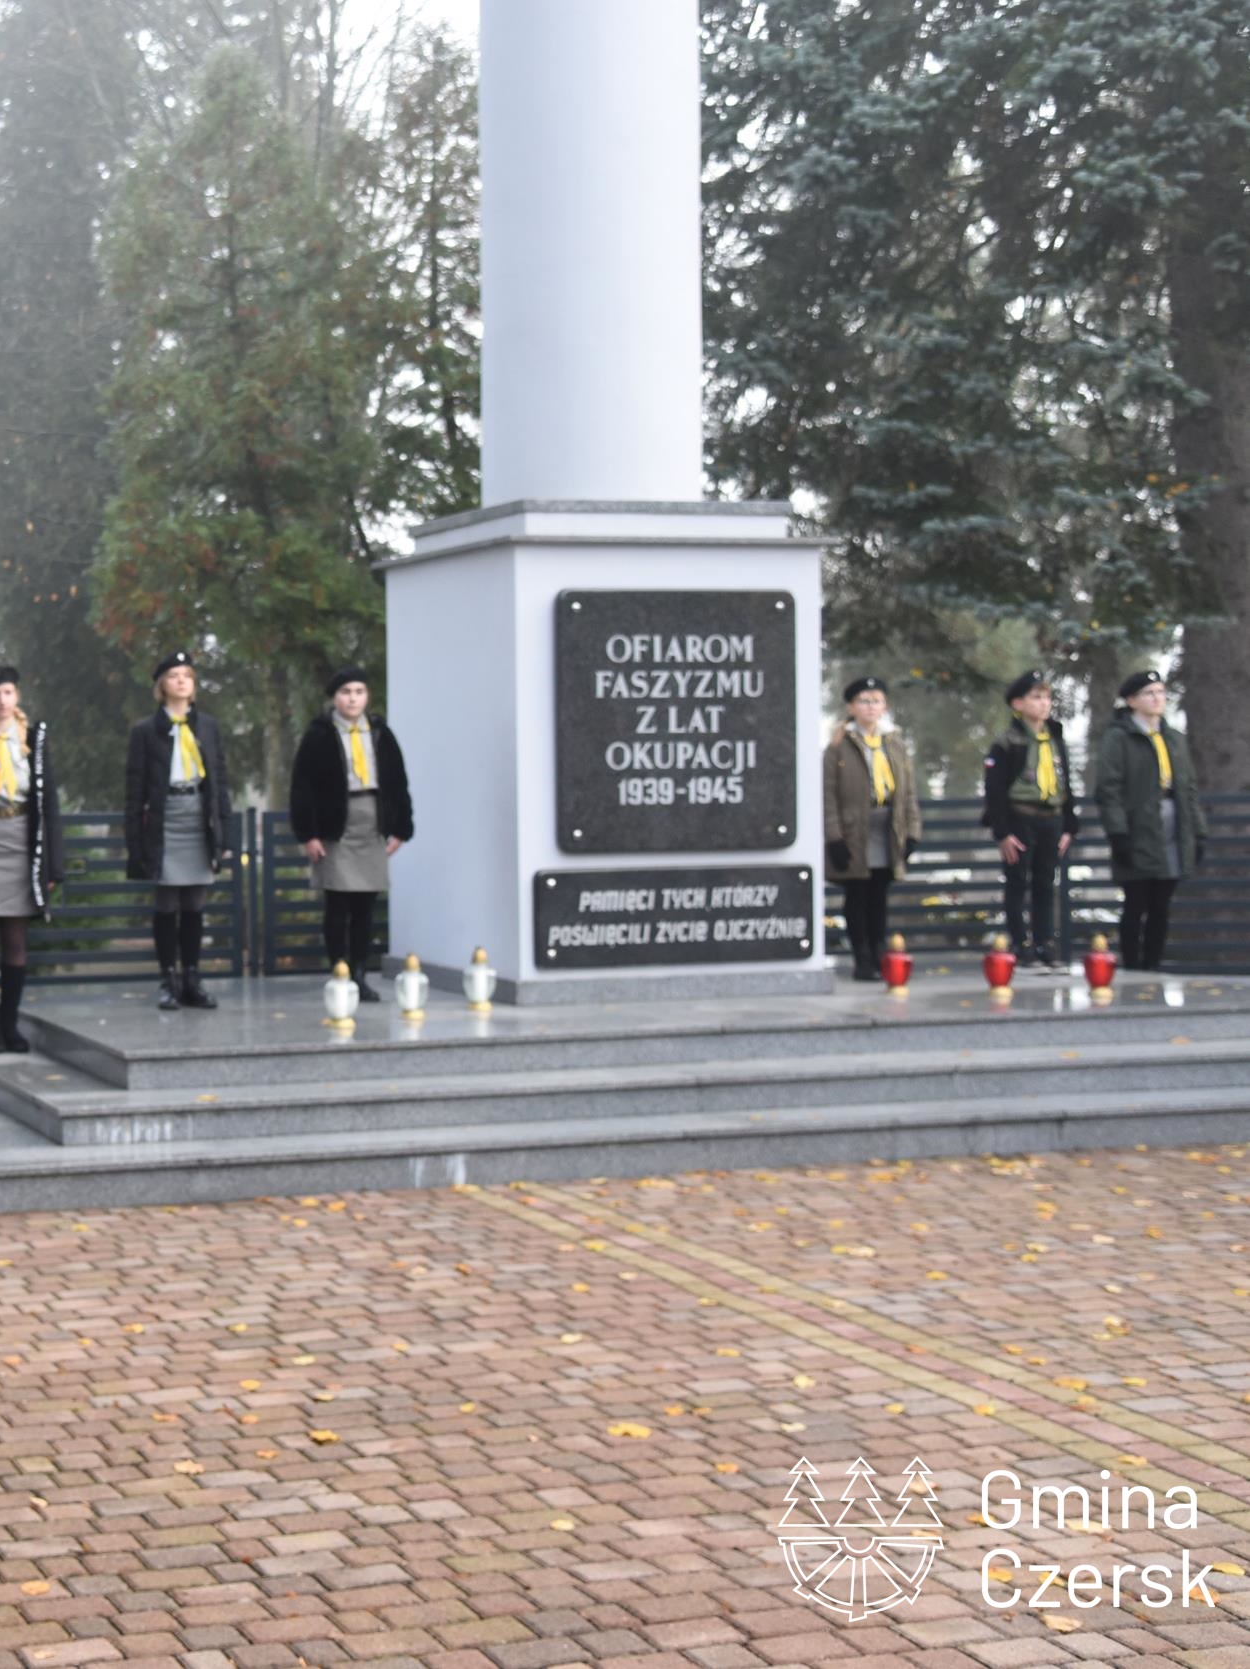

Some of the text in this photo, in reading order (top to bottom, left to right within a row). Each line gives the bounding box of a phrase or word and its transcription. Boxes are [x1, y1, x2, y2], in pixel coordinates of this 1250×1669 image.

[605, 633, 754, 664] OFIAROM
[594, 670, 765, 699] FASZYZMU
[635, 705, 726, 734] Z LAT
[605, 740, 757, 776] OKUPACJI
[618, 776, 744, 806] 1939-1945
[578, 888, 656, 915] PAMIĘCI
[711, 881, 779, 909] KTÓRZY
[548, 920, 651, 948] POŚWIĘCILI
